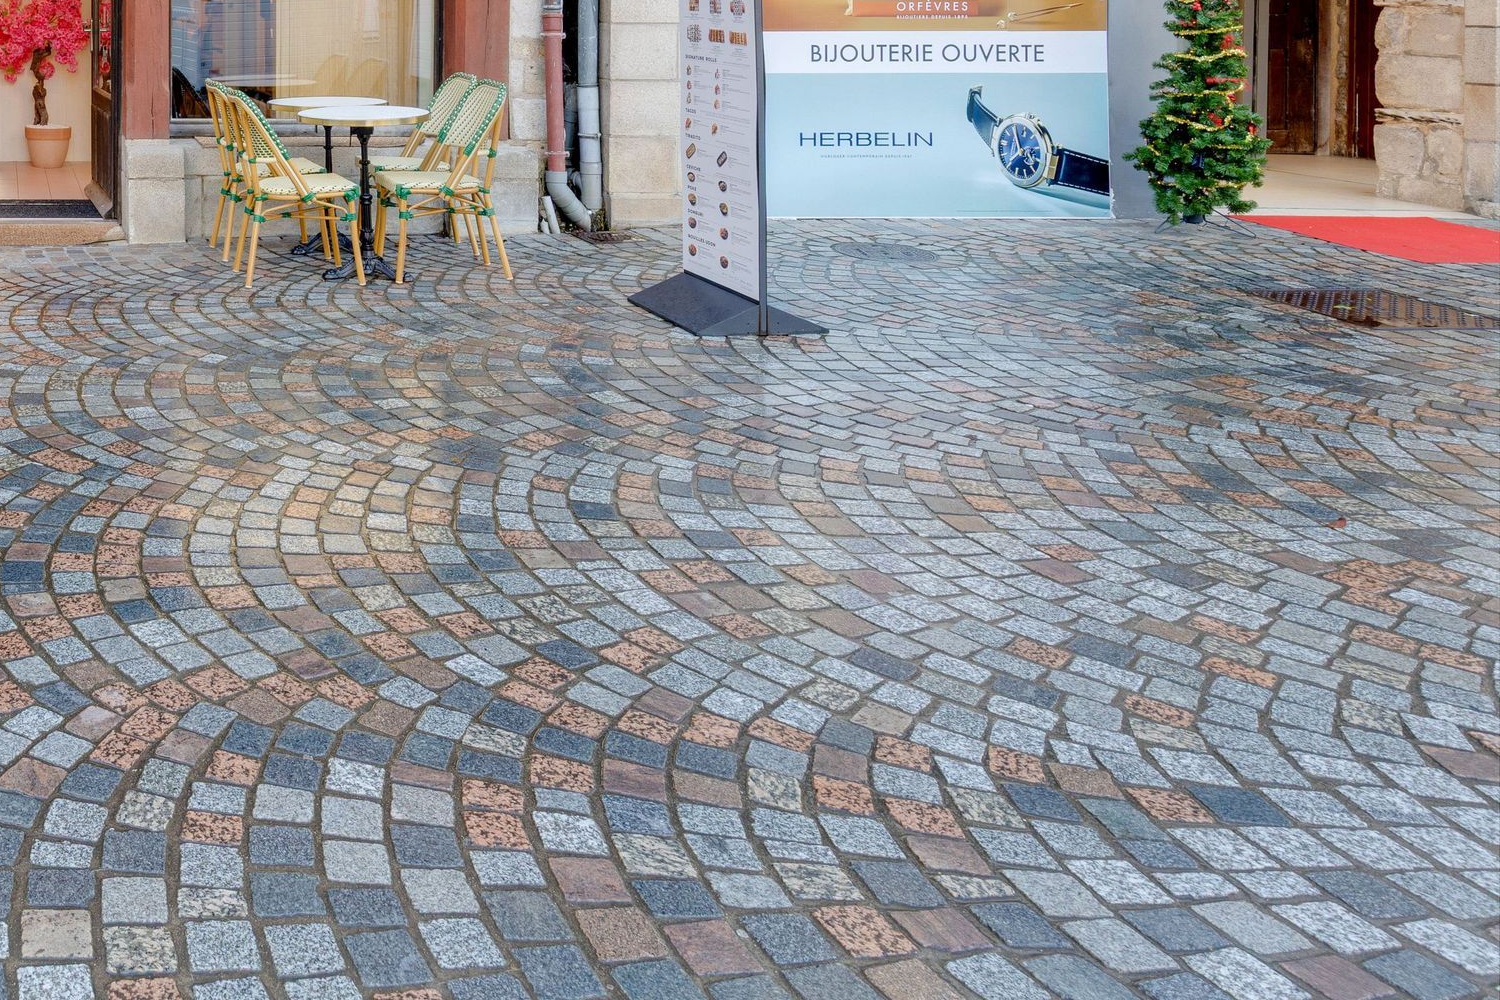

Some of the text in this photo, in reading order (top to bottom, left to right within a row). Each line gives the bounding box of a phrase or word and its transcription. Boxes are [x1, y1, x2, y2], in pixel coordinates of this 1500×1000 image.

[896, 0, 968, 11] ORFÈVRES
[810, 44, 1045, 62] BIJOUTERIE OUVERTE
[799, 132, 933, 146] HERBELIN
